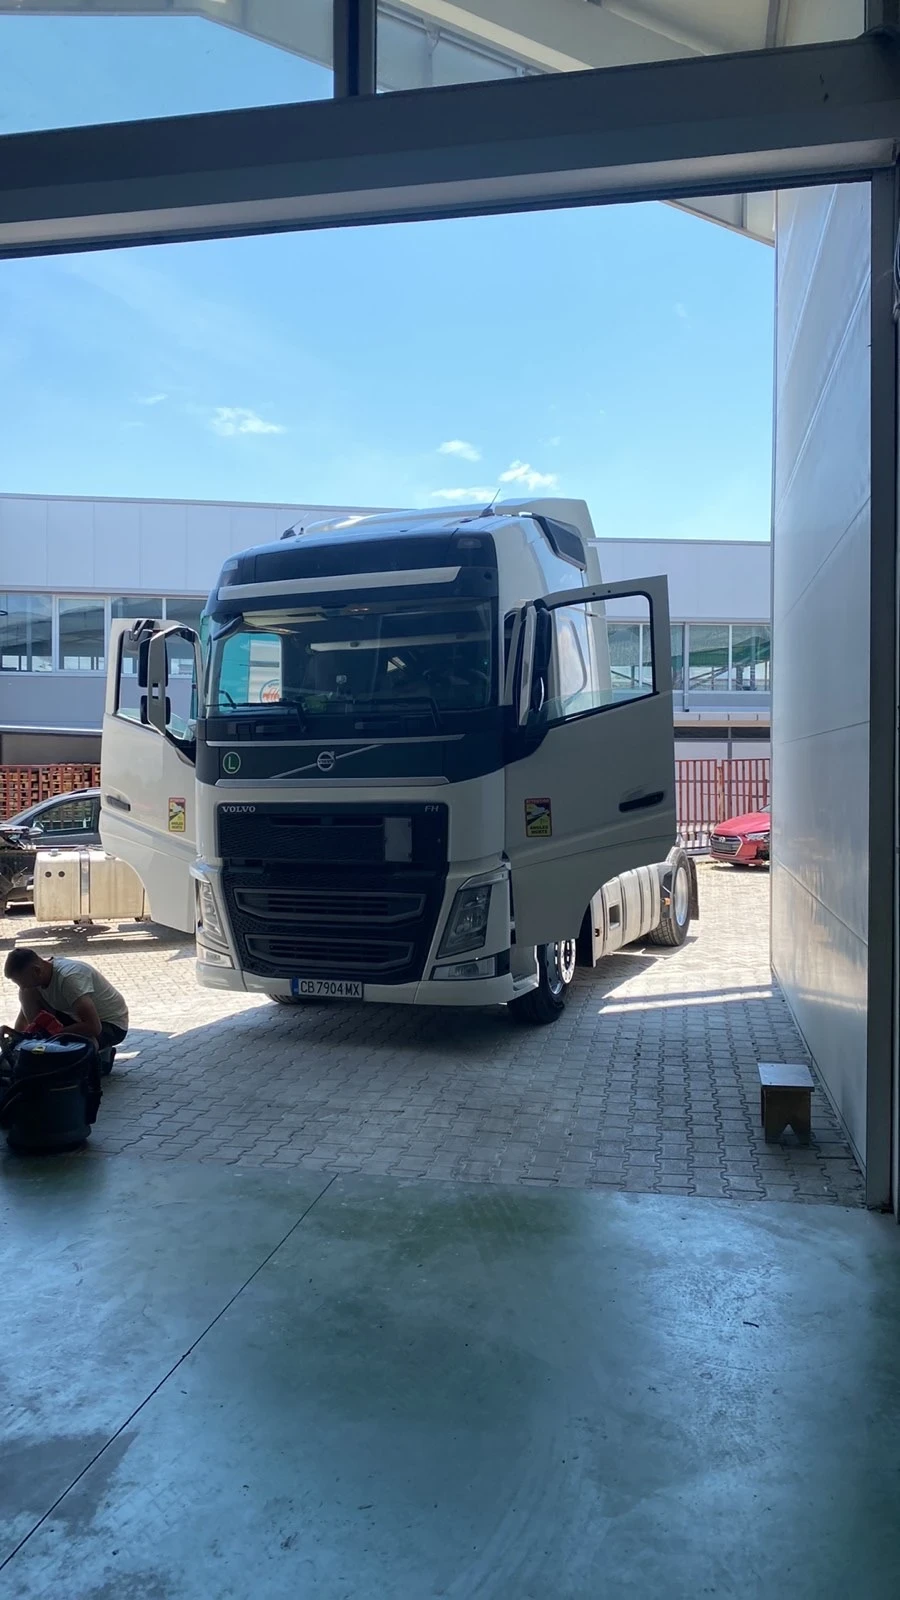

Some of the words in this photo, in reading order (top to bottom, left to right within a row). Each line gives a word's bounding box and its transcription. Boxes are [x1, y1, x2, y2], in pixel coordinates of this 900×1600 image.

[228, 756, 236, 770] L
[301, 981, 315, 993] CB
[317, 982, 343, 995] 7904
[345, 983, 360, 996] MX
